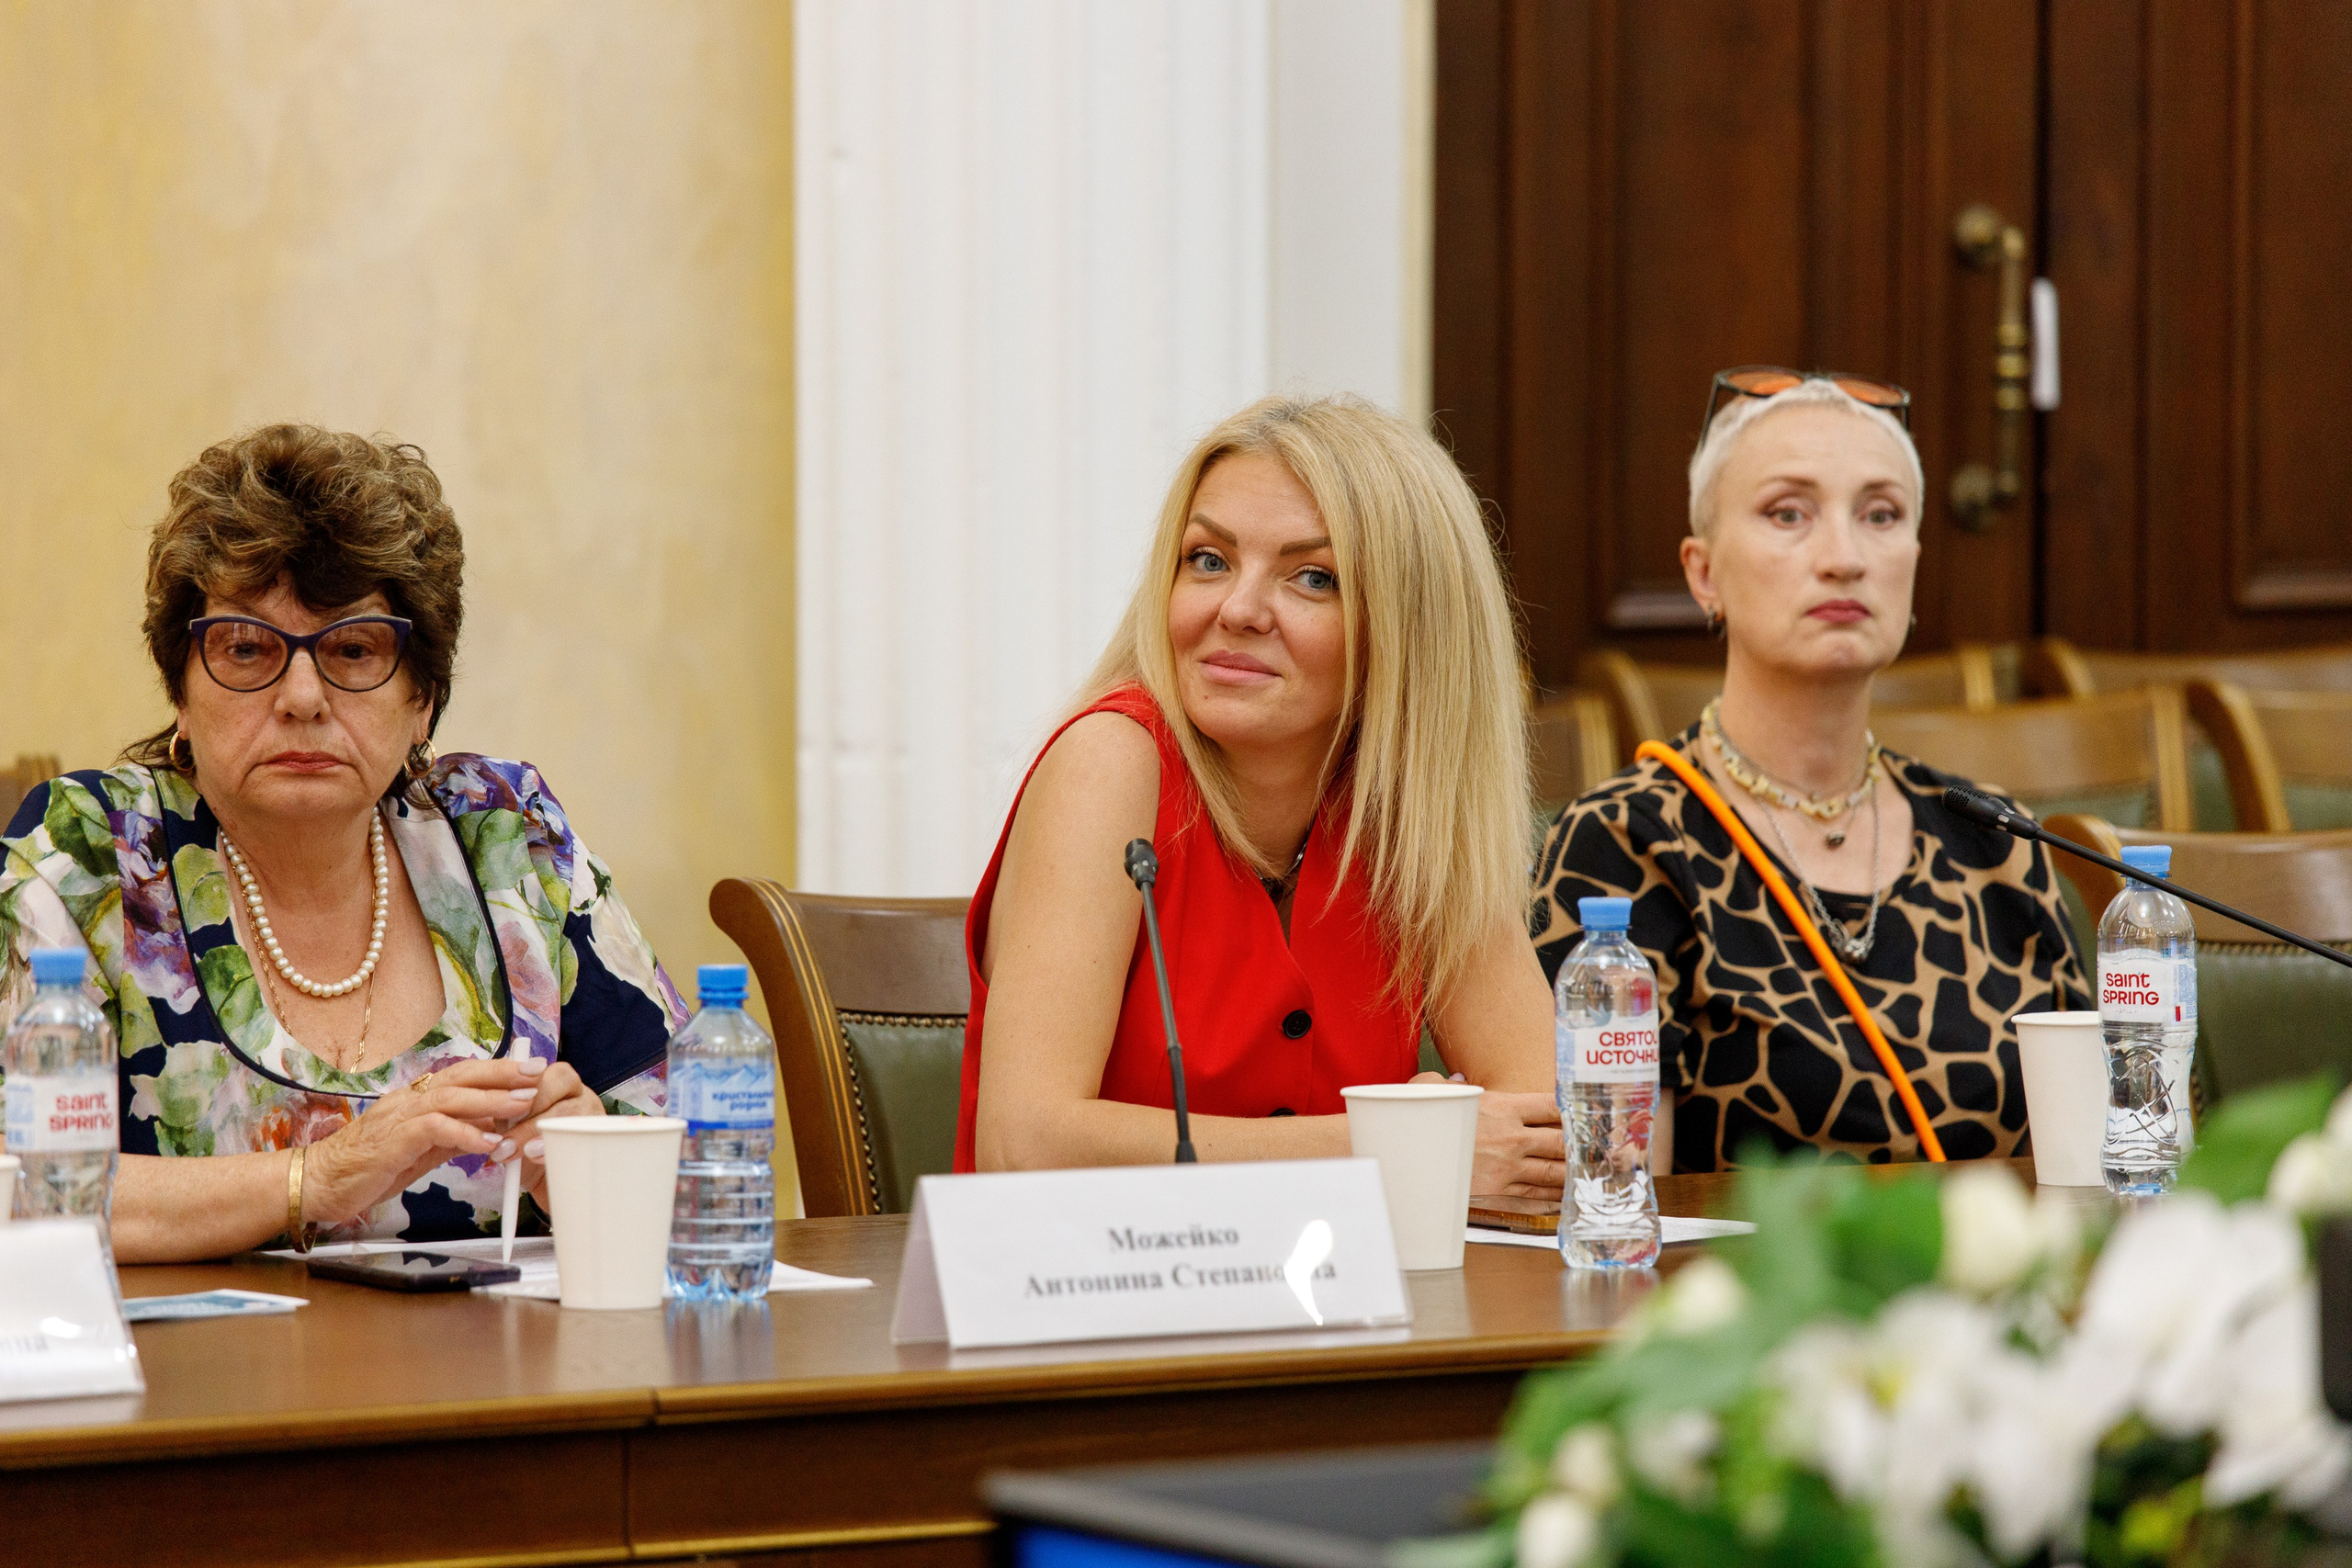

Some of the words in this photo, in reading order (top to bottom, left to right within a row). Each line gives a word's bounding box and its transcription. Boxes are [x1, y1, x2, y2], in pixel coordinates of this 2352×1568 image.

[2103, 989, 2159, 1005] SPRING
[1587, 1049, 1659, 1065] ИСТОЧНИ
[1108, 1223, 1239, 1253] Можейко
[1024, 1273, 1163, 1298] Антонина
[1171, 1261, 1336, 1288] Степаноа
